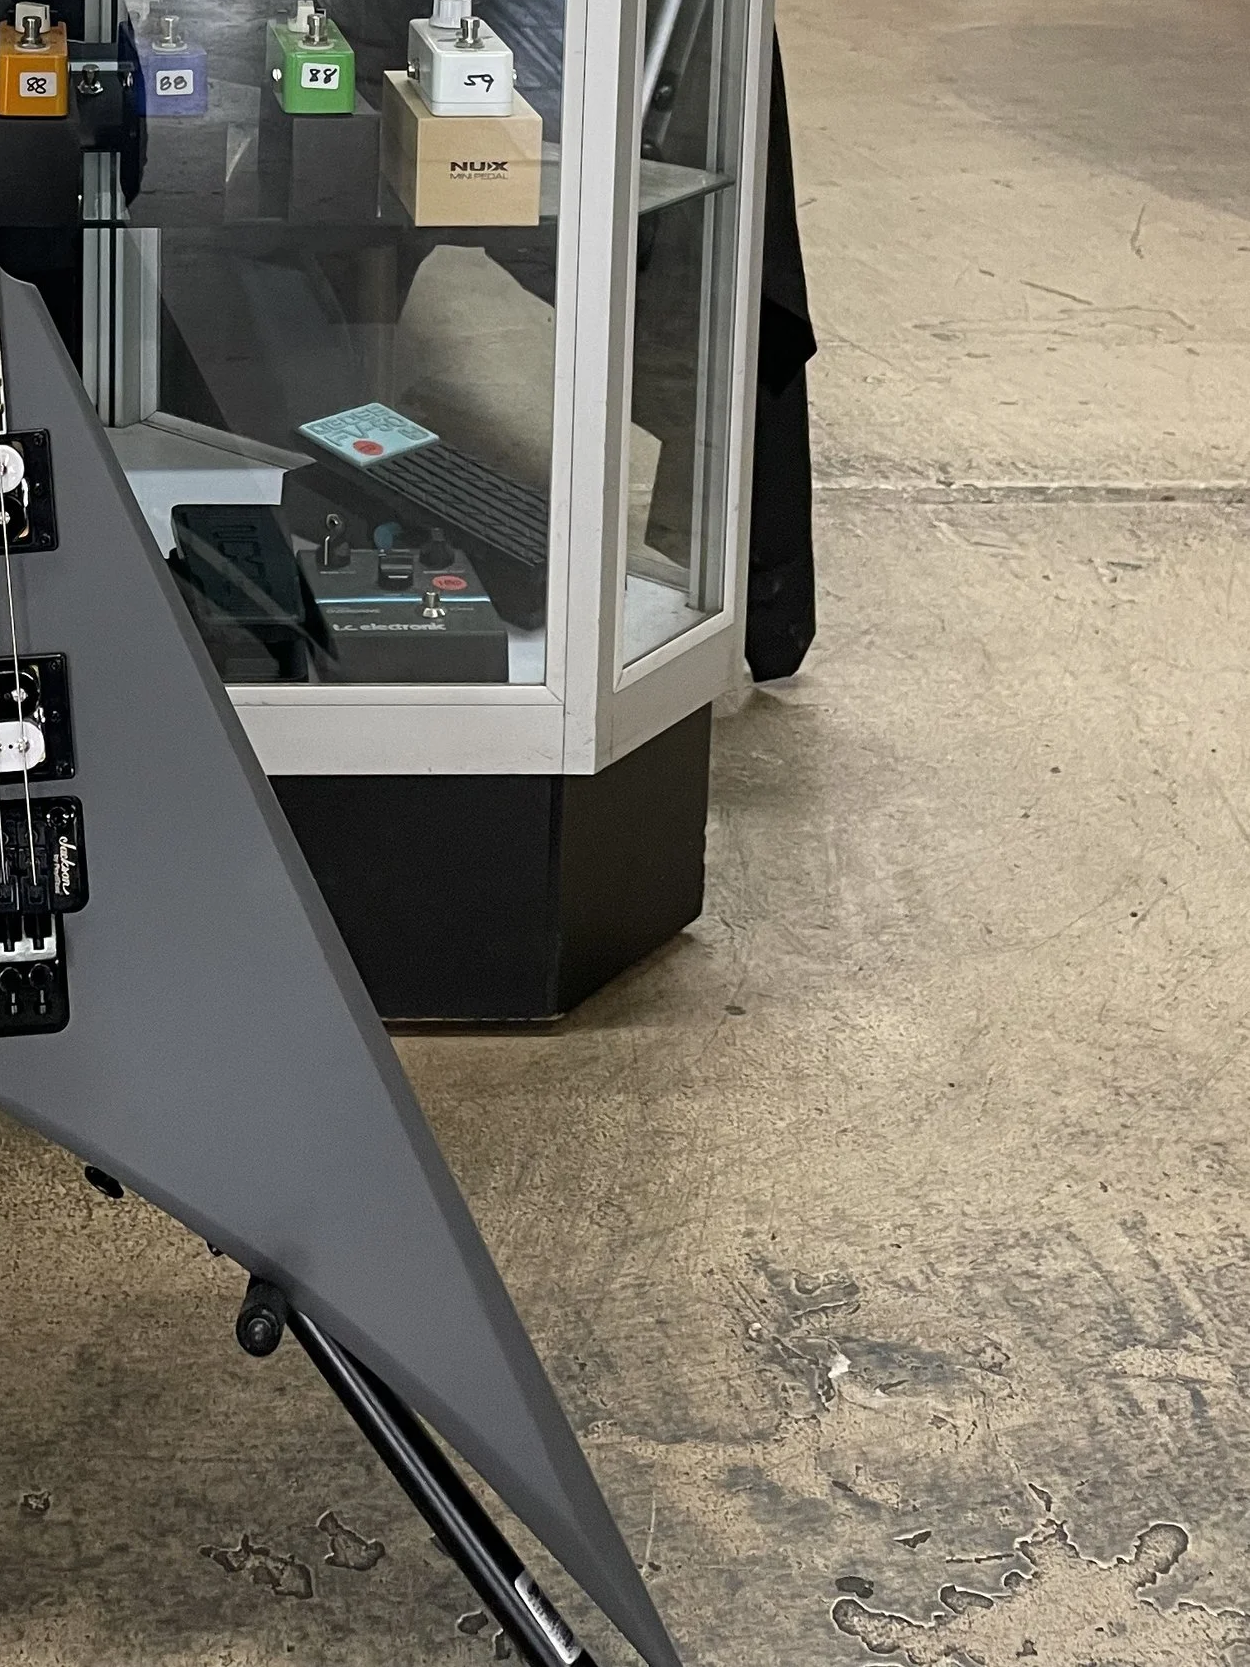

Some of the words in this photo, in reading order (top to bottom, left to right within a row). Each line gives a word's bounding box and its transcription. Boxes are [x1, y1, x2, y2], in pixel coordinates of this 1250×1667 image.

[159, 75, 188, 91] 88
[308, 68, 337, 84] 88
[463, 74, 495, 93] 59
[26, 76, 47, 94] 88
[450, 161, 510, 172] NUX
[473, 173, 510, 181] PEDAL
[359, 622, 447, 632] electronic
[58, 835, 78, 896] Jackson
